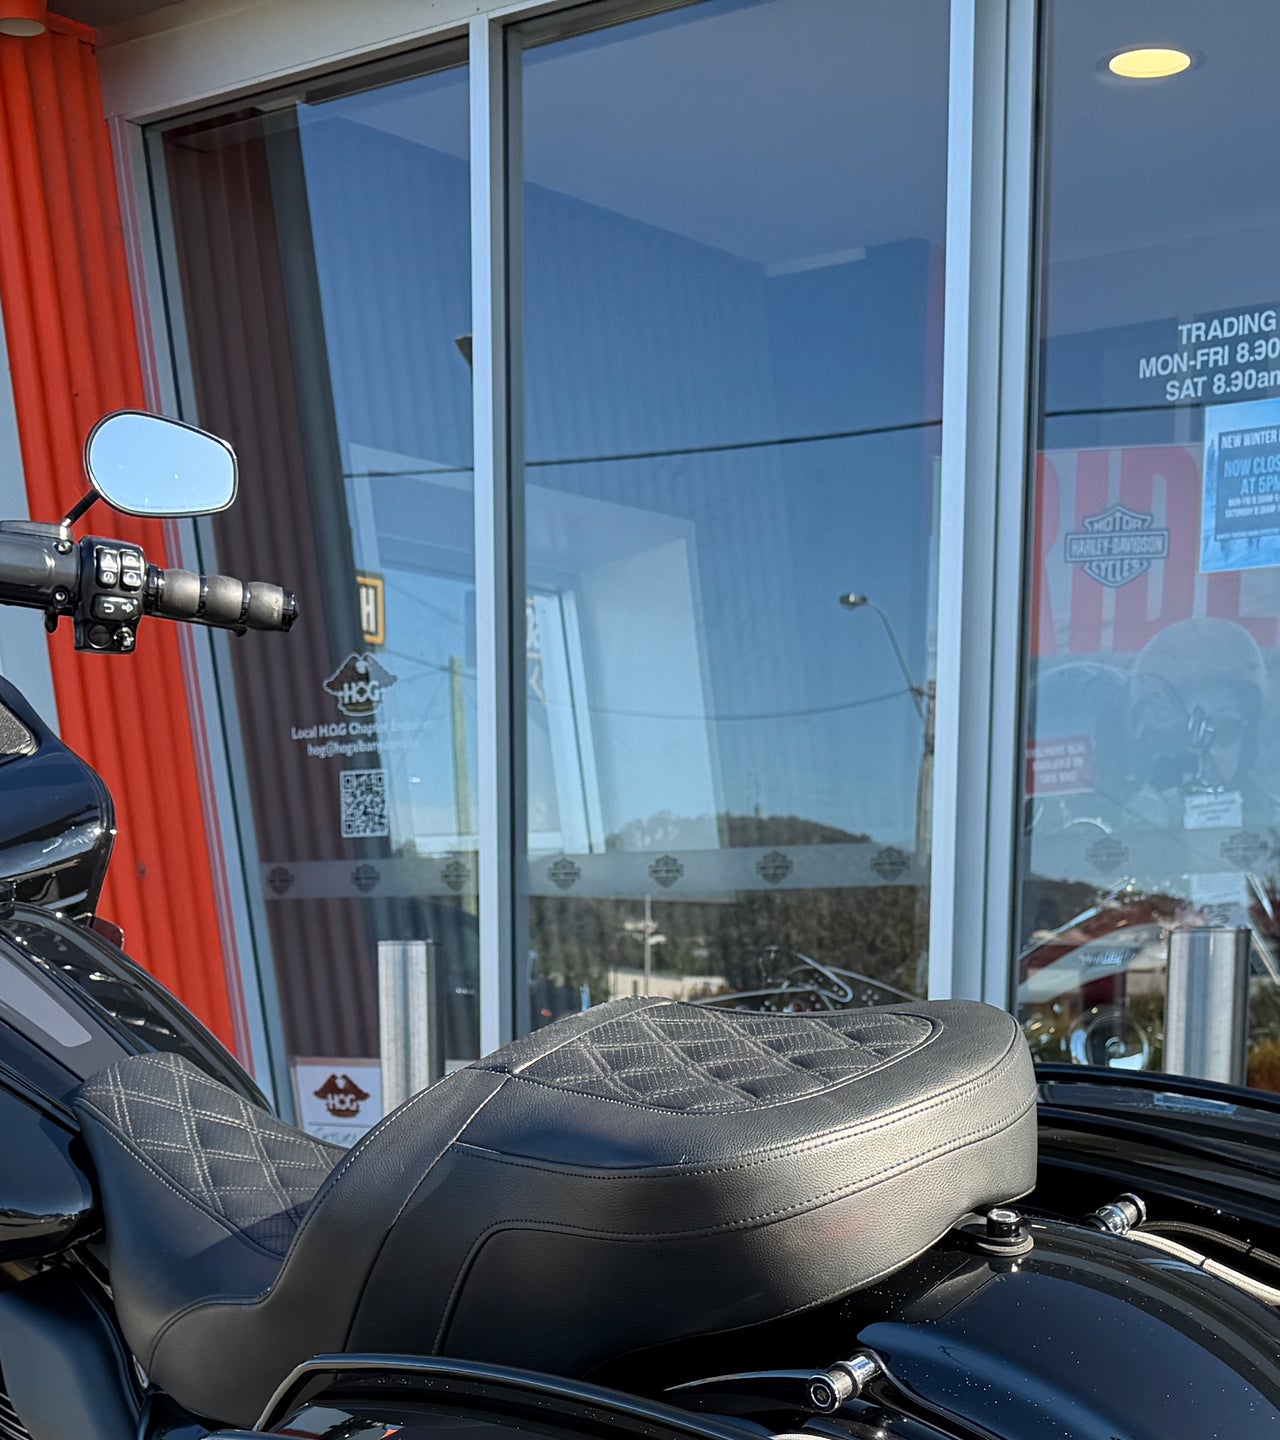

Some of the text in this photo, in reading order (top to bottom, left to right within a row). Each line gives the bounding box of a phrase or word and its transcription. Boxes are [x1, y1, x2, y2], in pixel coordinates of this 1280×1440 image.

[1178, 311, 1277, 344] TRADING
[1138, 345, 1230, 379] MON-FRI
[1165, 377, 1207, 402] SAT
[1220, 434, 1242, 449] NEW
[1243, 429, 1277, 447] WINTER
[1224, 457, 1251, 478] NOW
[1240, 477, 1256, 495] AT
